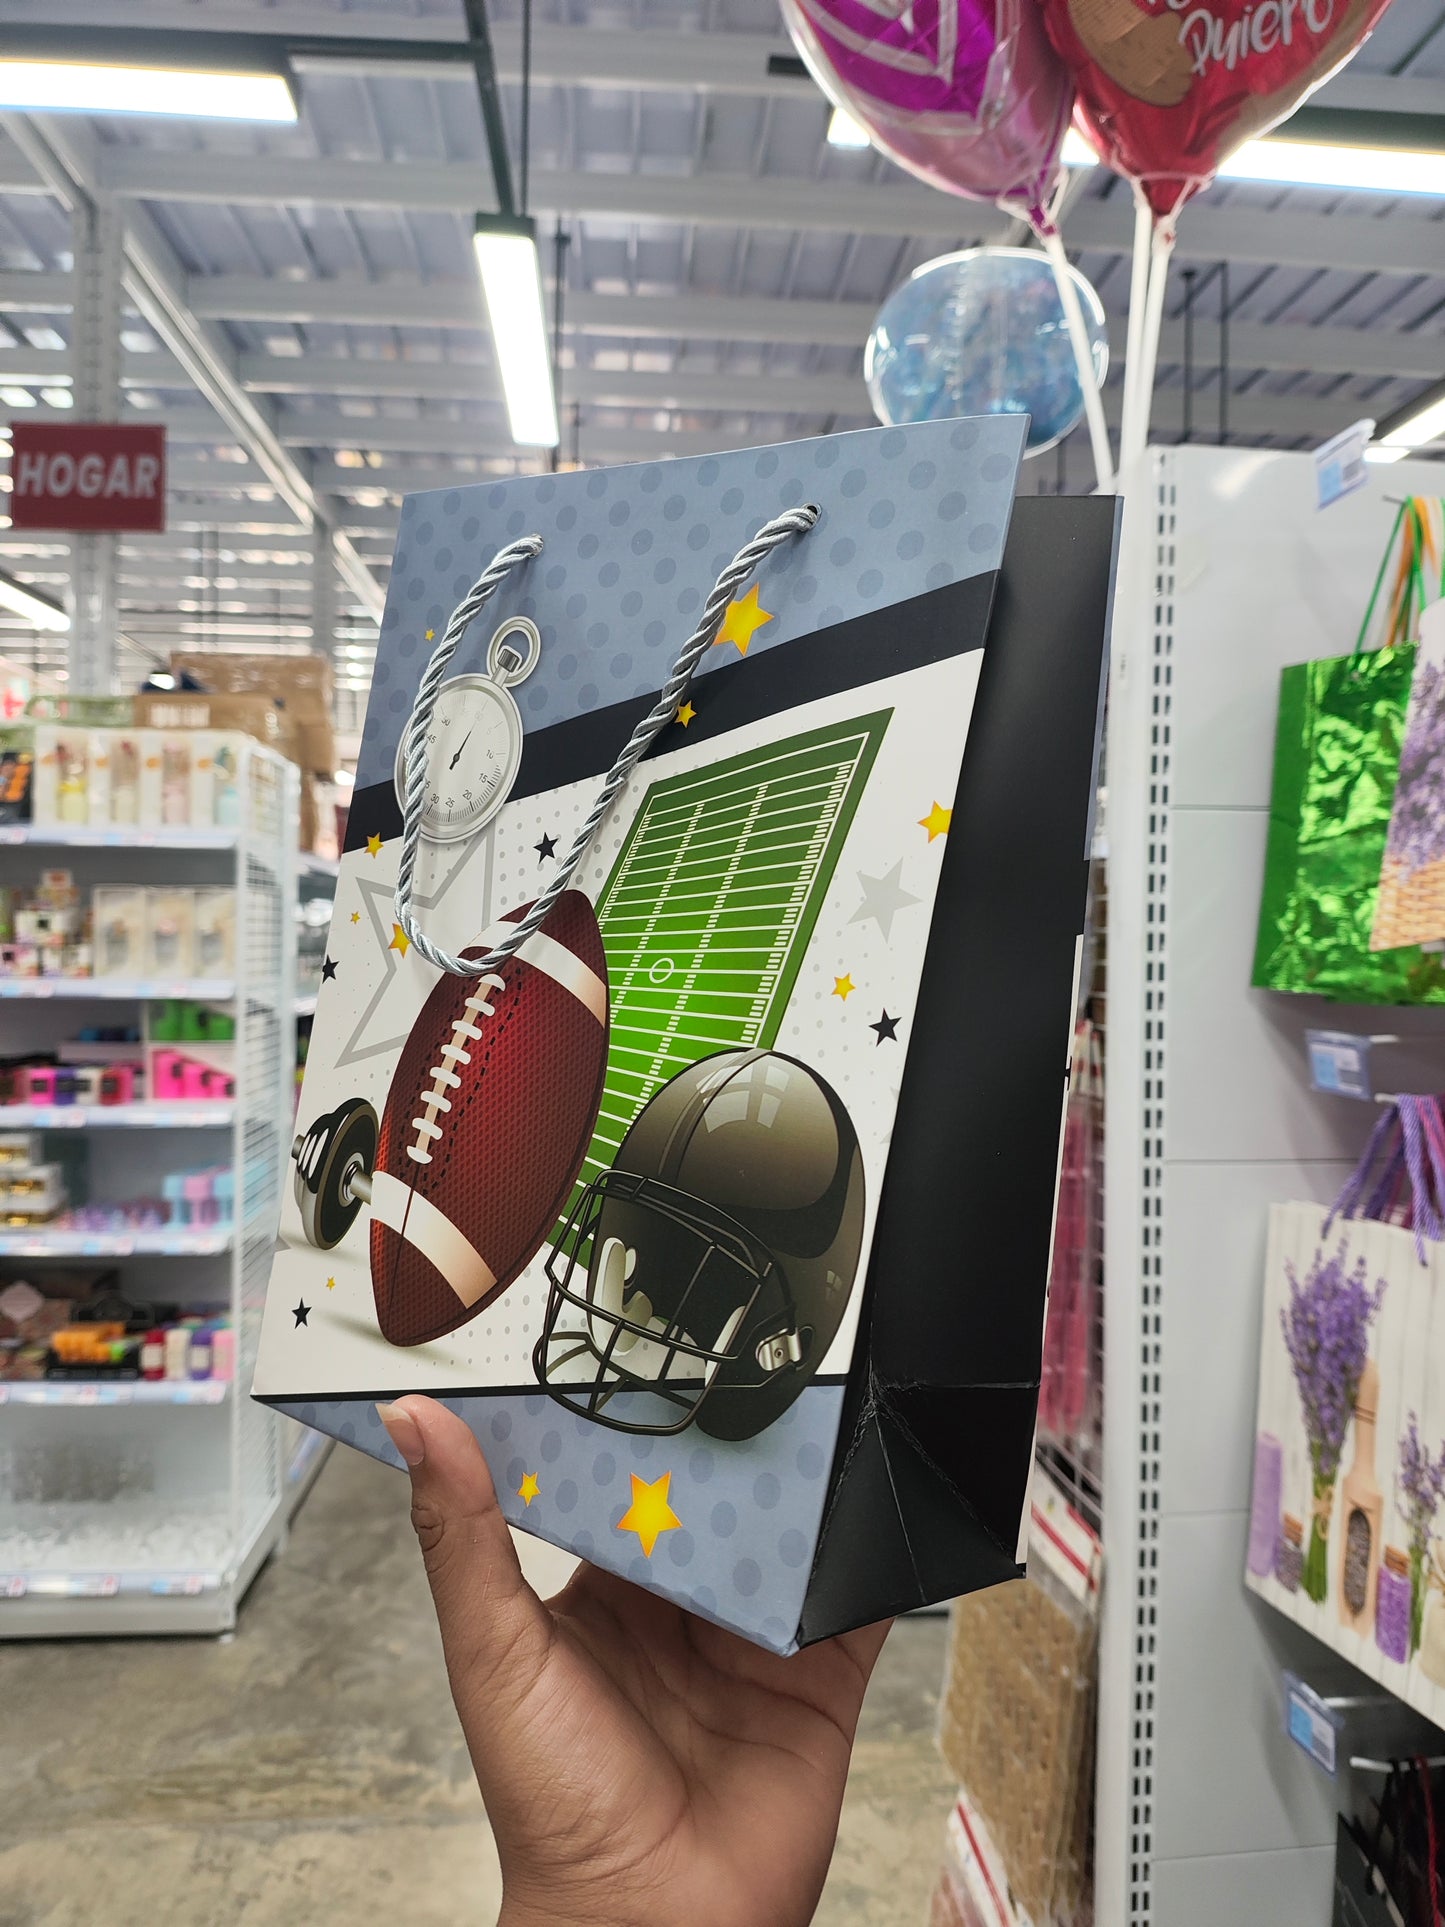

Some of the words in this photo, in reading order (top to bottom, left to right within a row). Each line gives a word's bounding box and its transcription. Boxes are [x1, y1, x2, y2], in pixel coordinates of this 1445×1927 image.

[1178, 0, 1334, 76] Quiero
[17, 453, 158, 498] HOGAR
[427, 734, 437, 744] 45
[486, 749, 494, 760] 10
[479, 773, 488, 784] 15
[430, 793, 440, 805] 30
[462, 789, 473, 800] 20
[445, 797, 455, 808] 25
